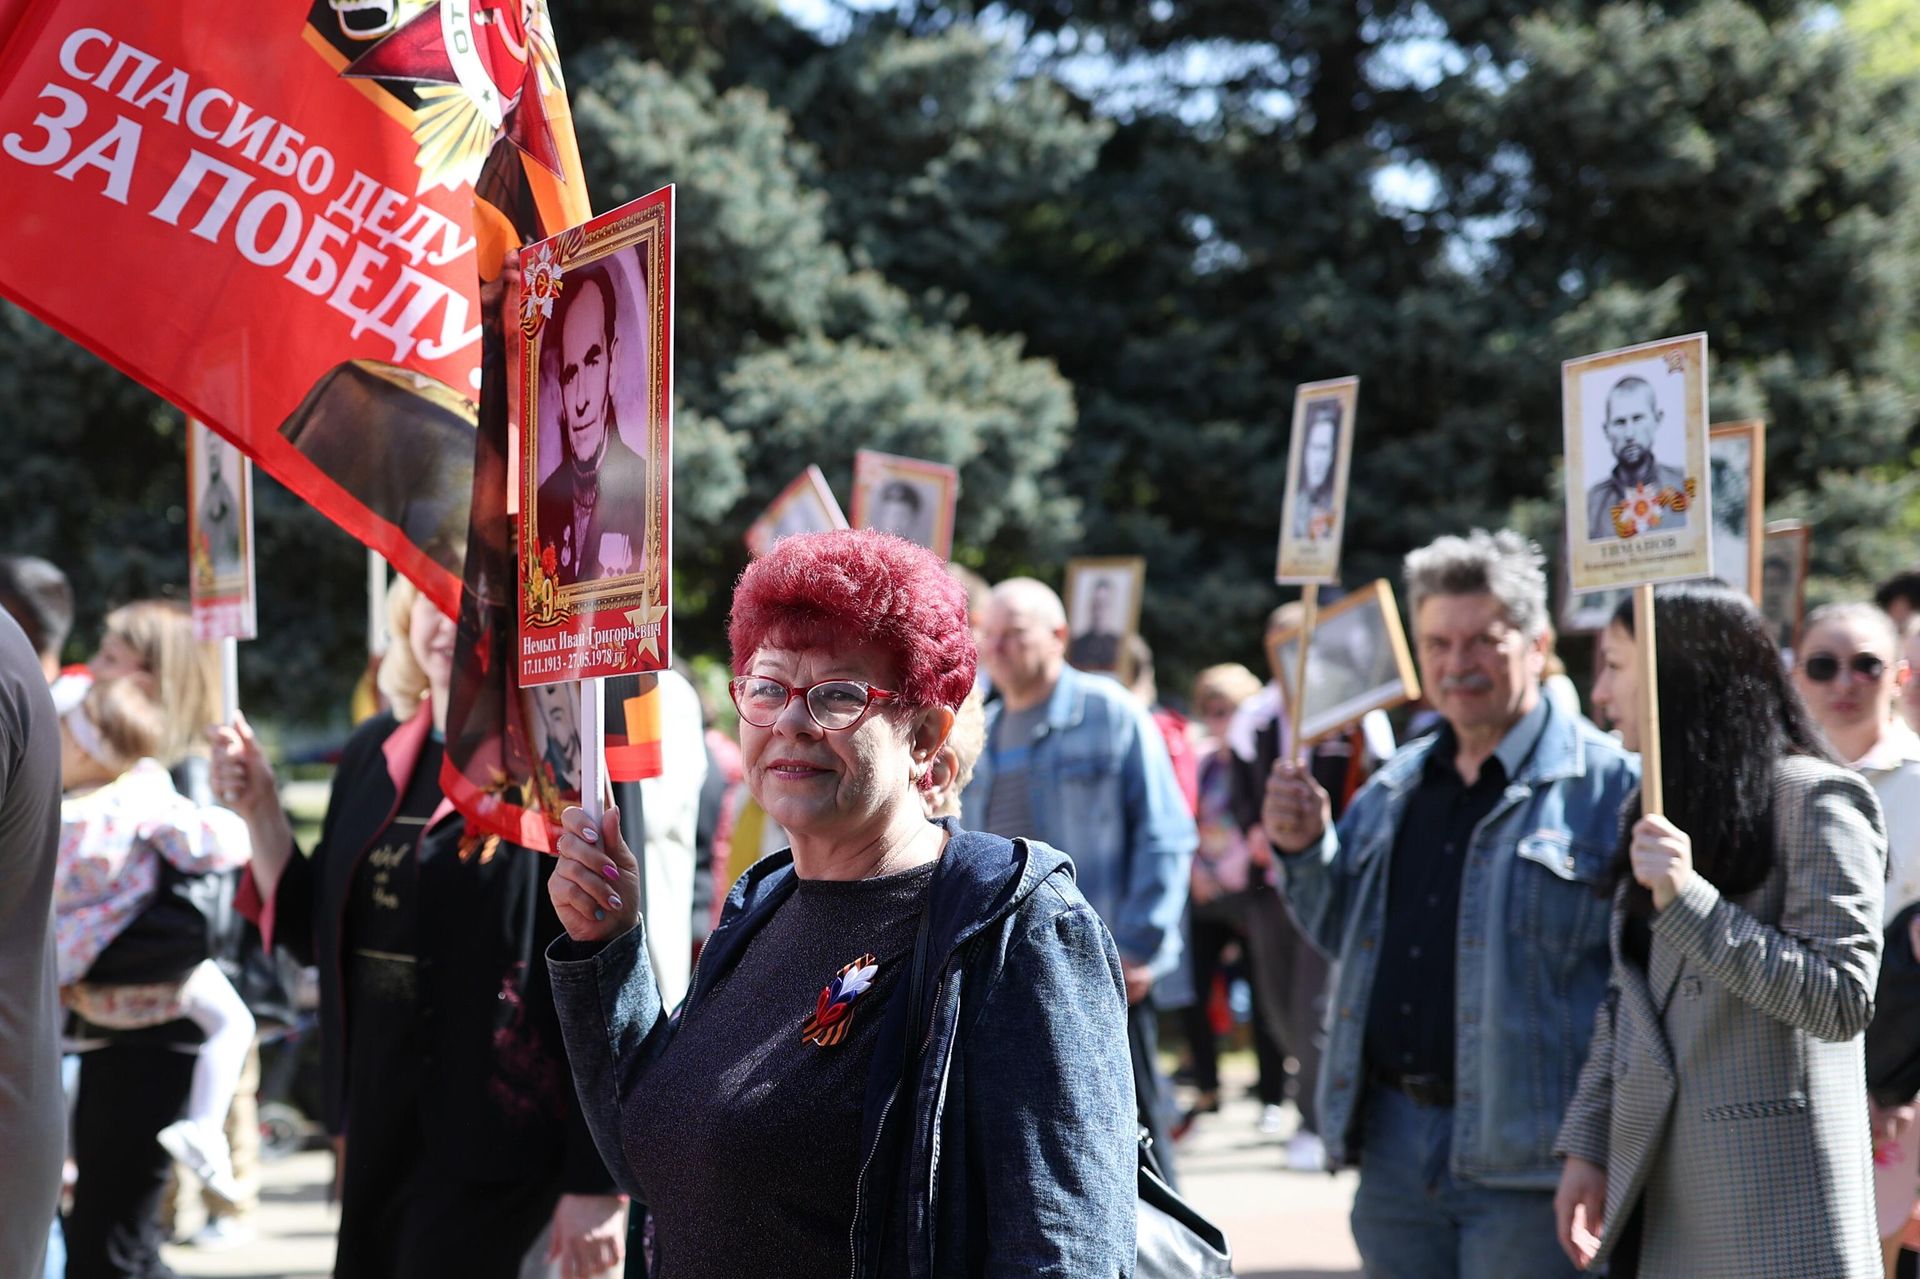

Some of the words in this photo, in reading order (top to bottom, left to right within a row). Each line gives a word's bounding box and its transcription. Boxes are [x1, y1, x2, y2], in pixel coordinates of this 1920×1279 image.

[2, 82, 144, 205] ЗА
[58, 27, 336, 196] СПАСИБО
[324, 170, 477, 267] ДЕДУ
[523, 636, 557, 655] Немых
[559, 630, 585, 649] Иван
[588, 622, 662, 649] Григорьевич
[523, 655, 562, 675] 17.11.1913
[568, 649, 612, 669] 27.05.1978
